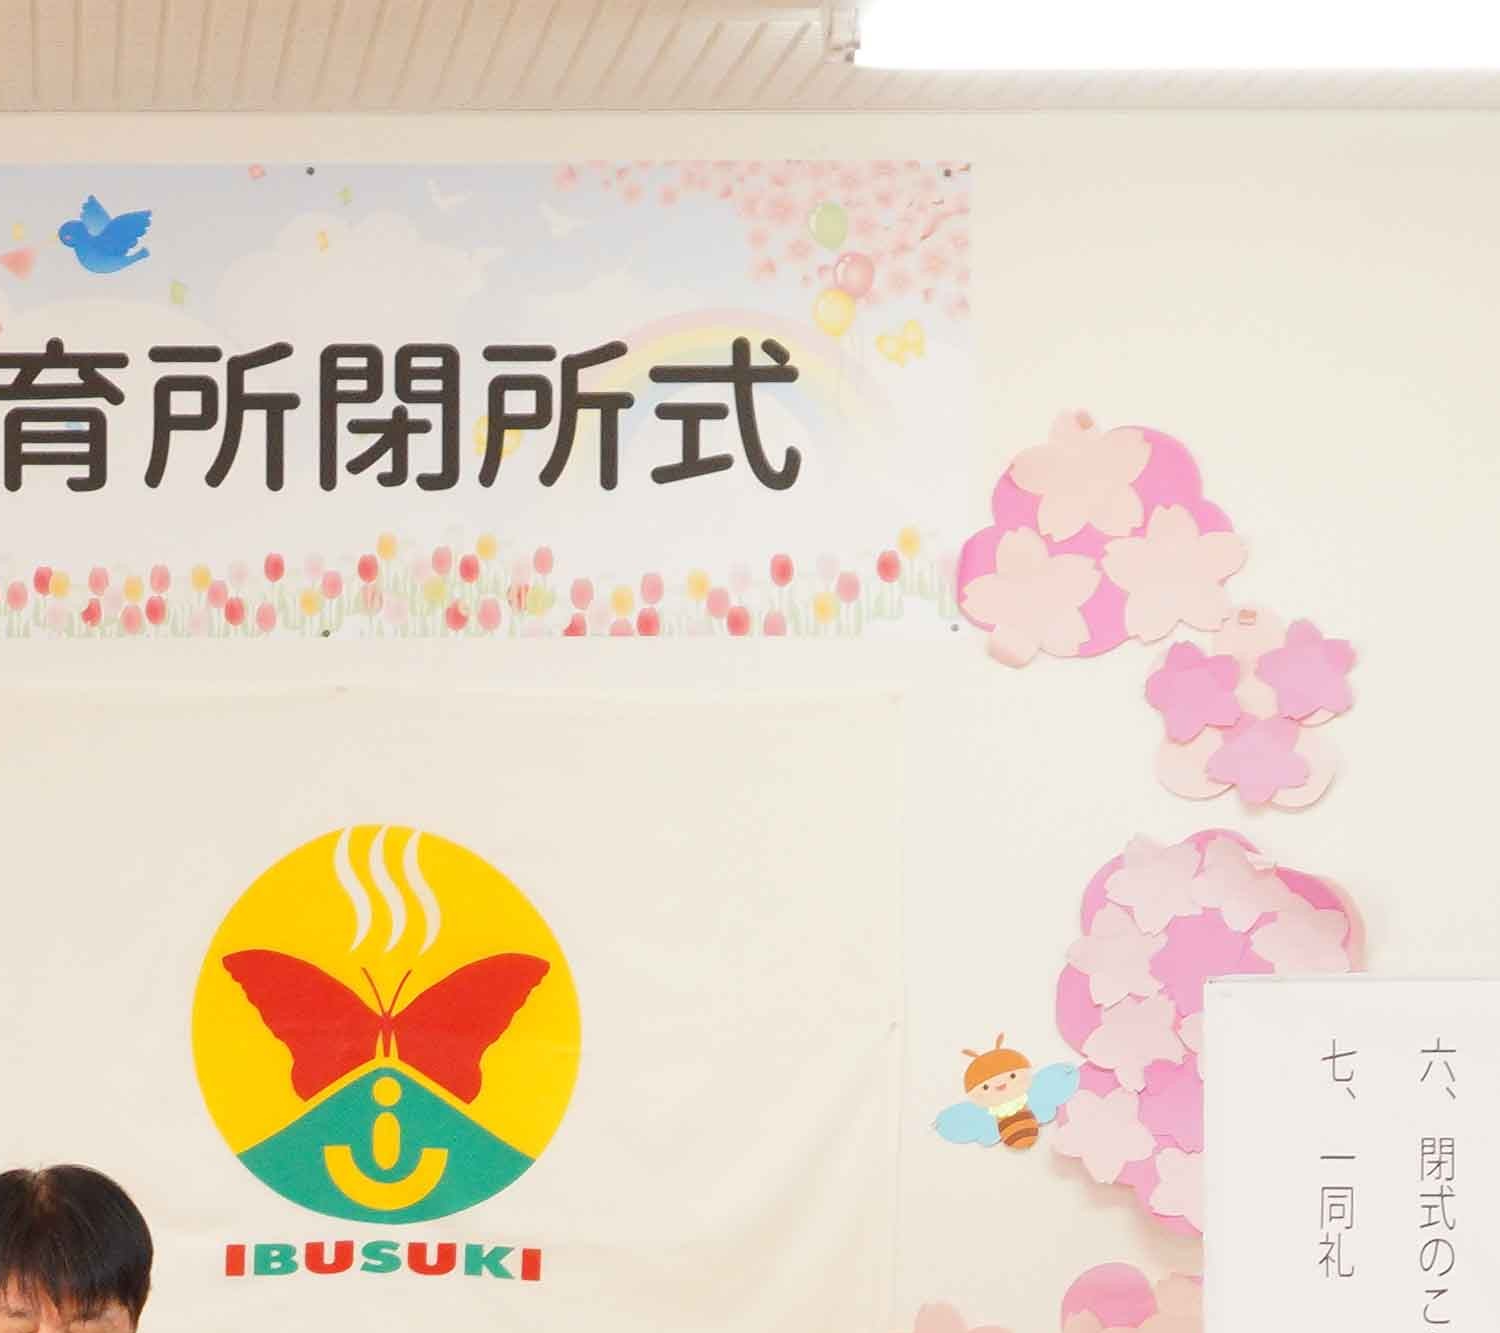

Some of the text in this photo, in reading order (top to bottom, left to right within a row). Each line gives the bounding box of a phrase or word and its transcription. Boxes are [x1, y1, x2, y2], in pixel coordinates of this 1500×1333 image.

[1317, 1037, 1358, 1279] 七、一同礼
[224, 1239, 543, 1282] IBUSUKI
